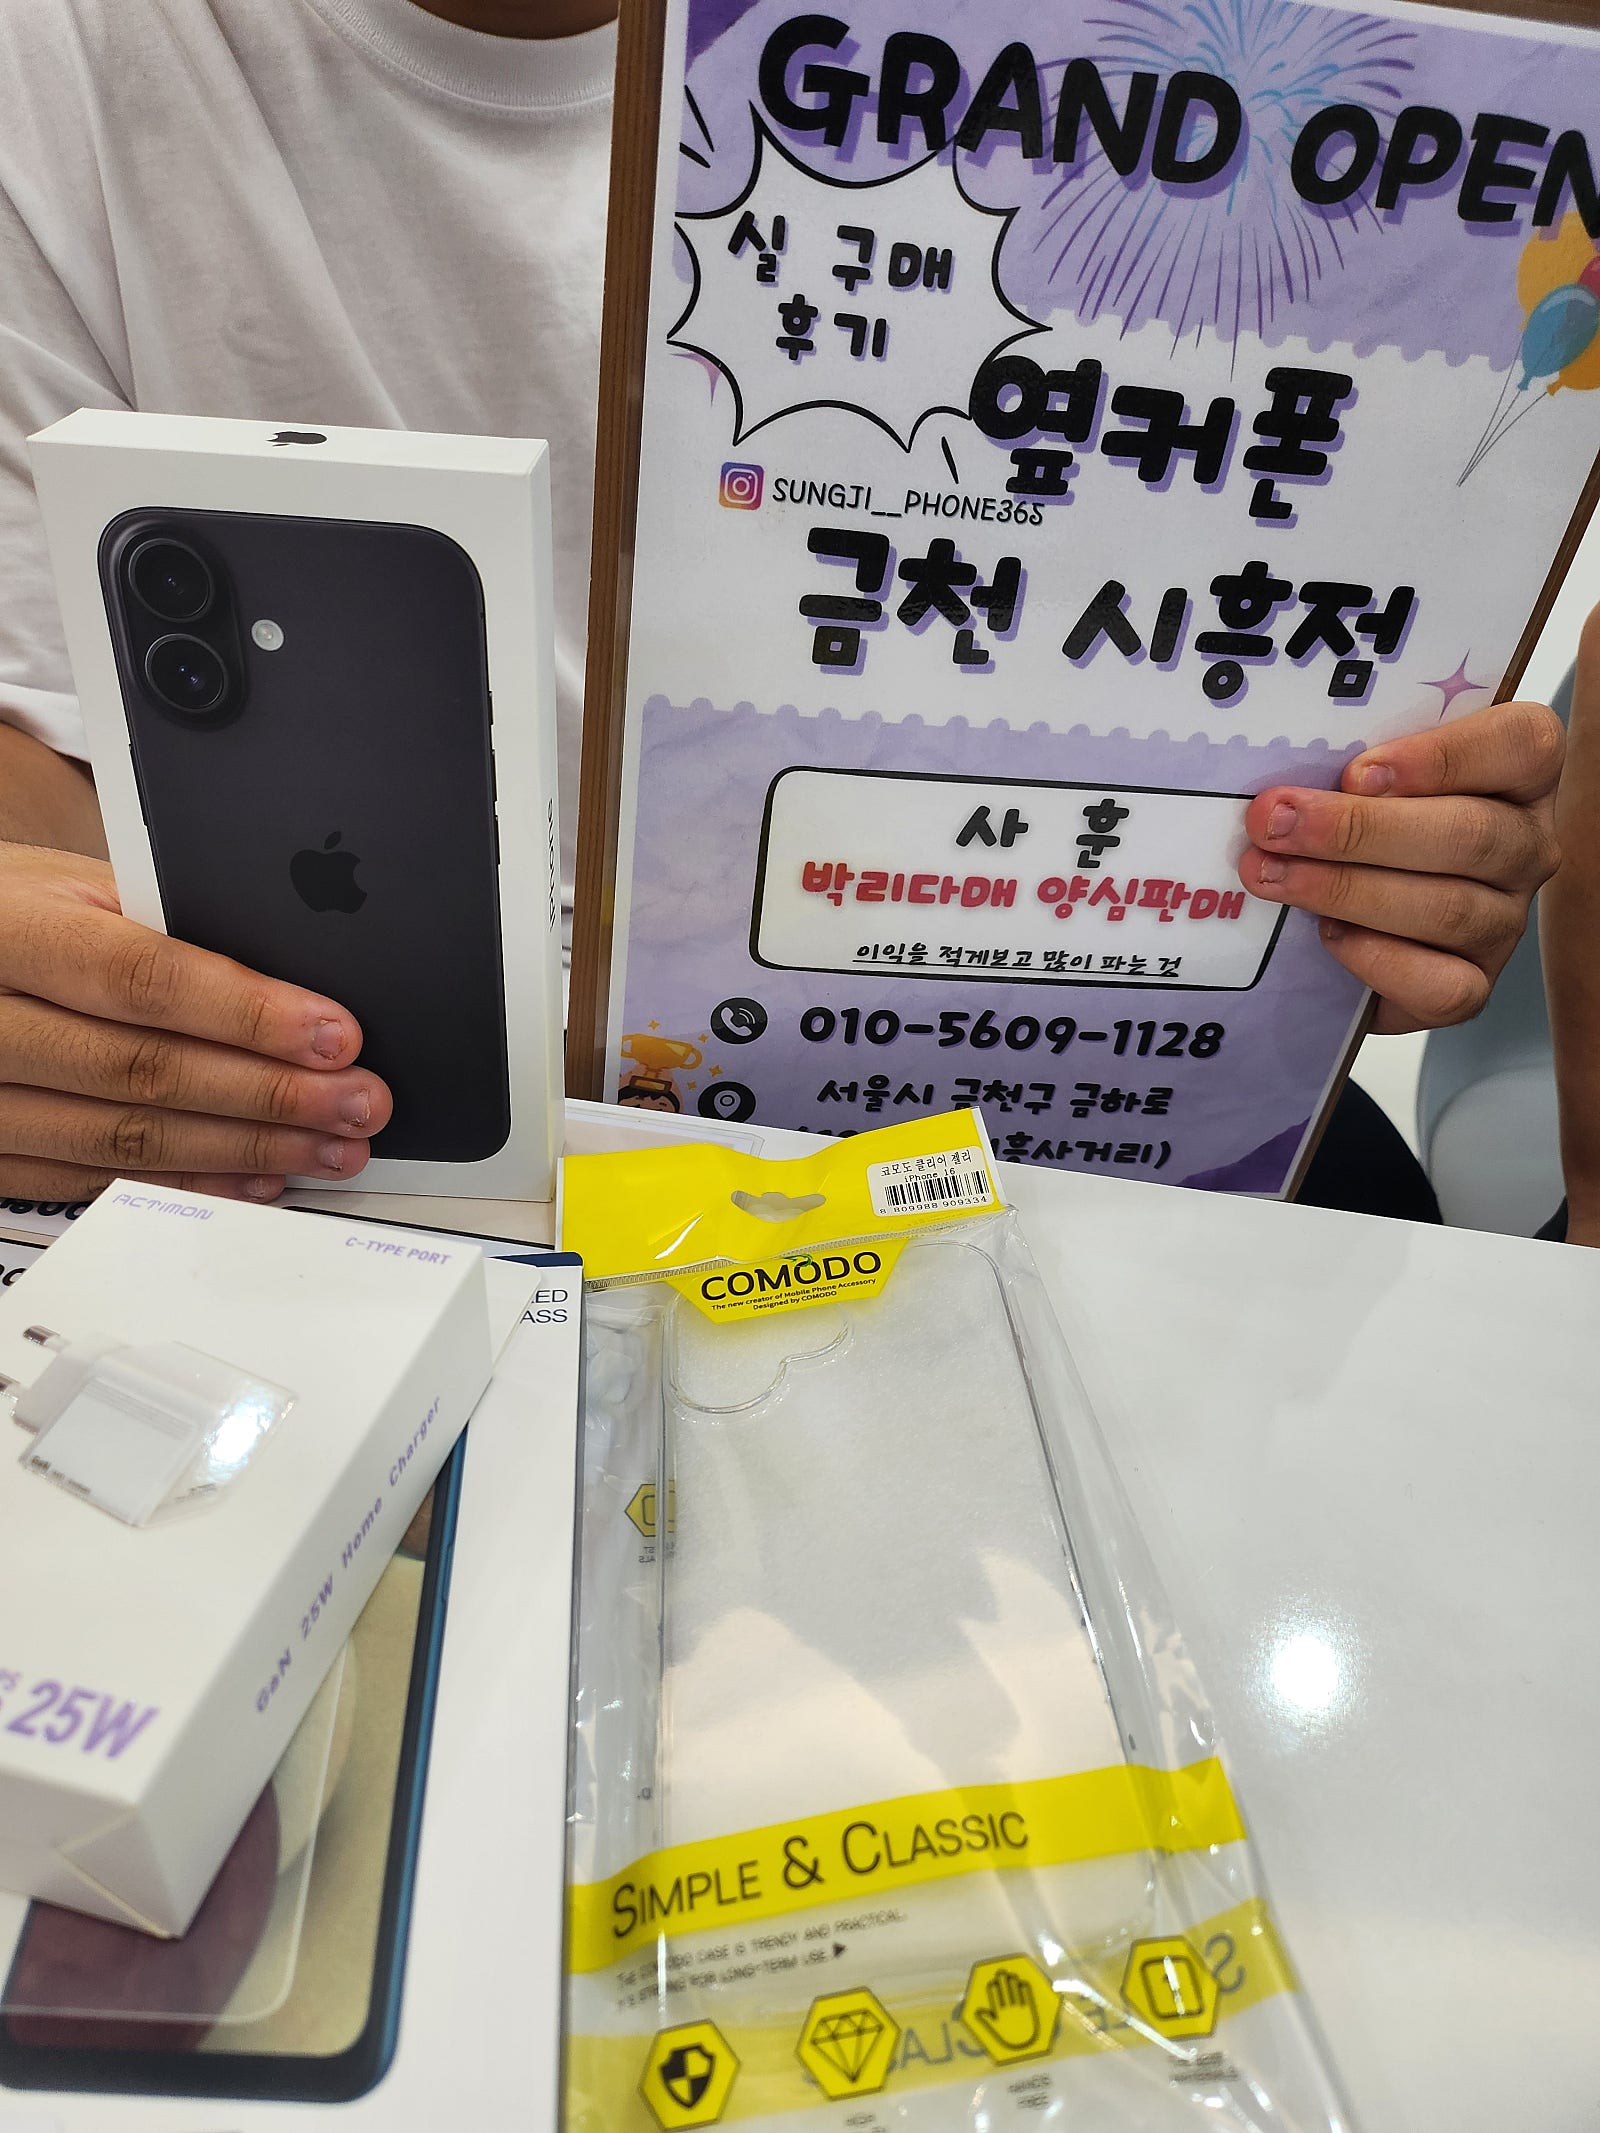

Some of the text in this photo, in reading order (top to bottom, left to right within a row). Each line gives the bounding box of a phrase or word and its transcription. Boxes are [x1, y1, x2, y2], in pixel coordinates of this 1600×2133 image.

[758, 13, 1600, 239] GRAND OPEN
[728, 211, 953, 291] 실 구매
[776, 293, 887, 361] 후기
[969, 355, 1353, 520] 옆커폰
[800, 527, 1416, 702] 금천 시흥점
[955, 798, 1130, 869] 사 훈
[547, 797, 556, 933] iPhone
[801, 860, 1246, 923] 박리다매 양심판매
[856, 942, 1183, 978] 이익을 적게보고 많이 파는 것
[800, 1005, 1226, 1060] 010-5609-1128
[816, 1074, 1174, 1117] 서울시 금천구 금하로
[881, 1149, 972, 1177] 코모도 클리어 젤리
[904, 1167, 956, 1183] iPhone 16
[893, 1202, 939, 1214] 809988
[942, 1195, 988, 1208] 909334
[345, 1236, 452, 1266] C-TYPE PORT
[701, 1251, 882, 1301] COMODO
[531, 1289, 568, 1303] ED
[745, 1296, 773, 1305] creator
[784, 1289, 810, 1299] Mobile
[811, 1284, 837, 1294] Phone
[838, 1278, 876, 1290] Accessory
[753, 1290, 837, 1311] Designed by COMODO
[256, 1396, 441, 1714] GaN 25W Home Charger
[6, 1679, 159, 1759] 25W
[782, 1834, 824, 1889] &
